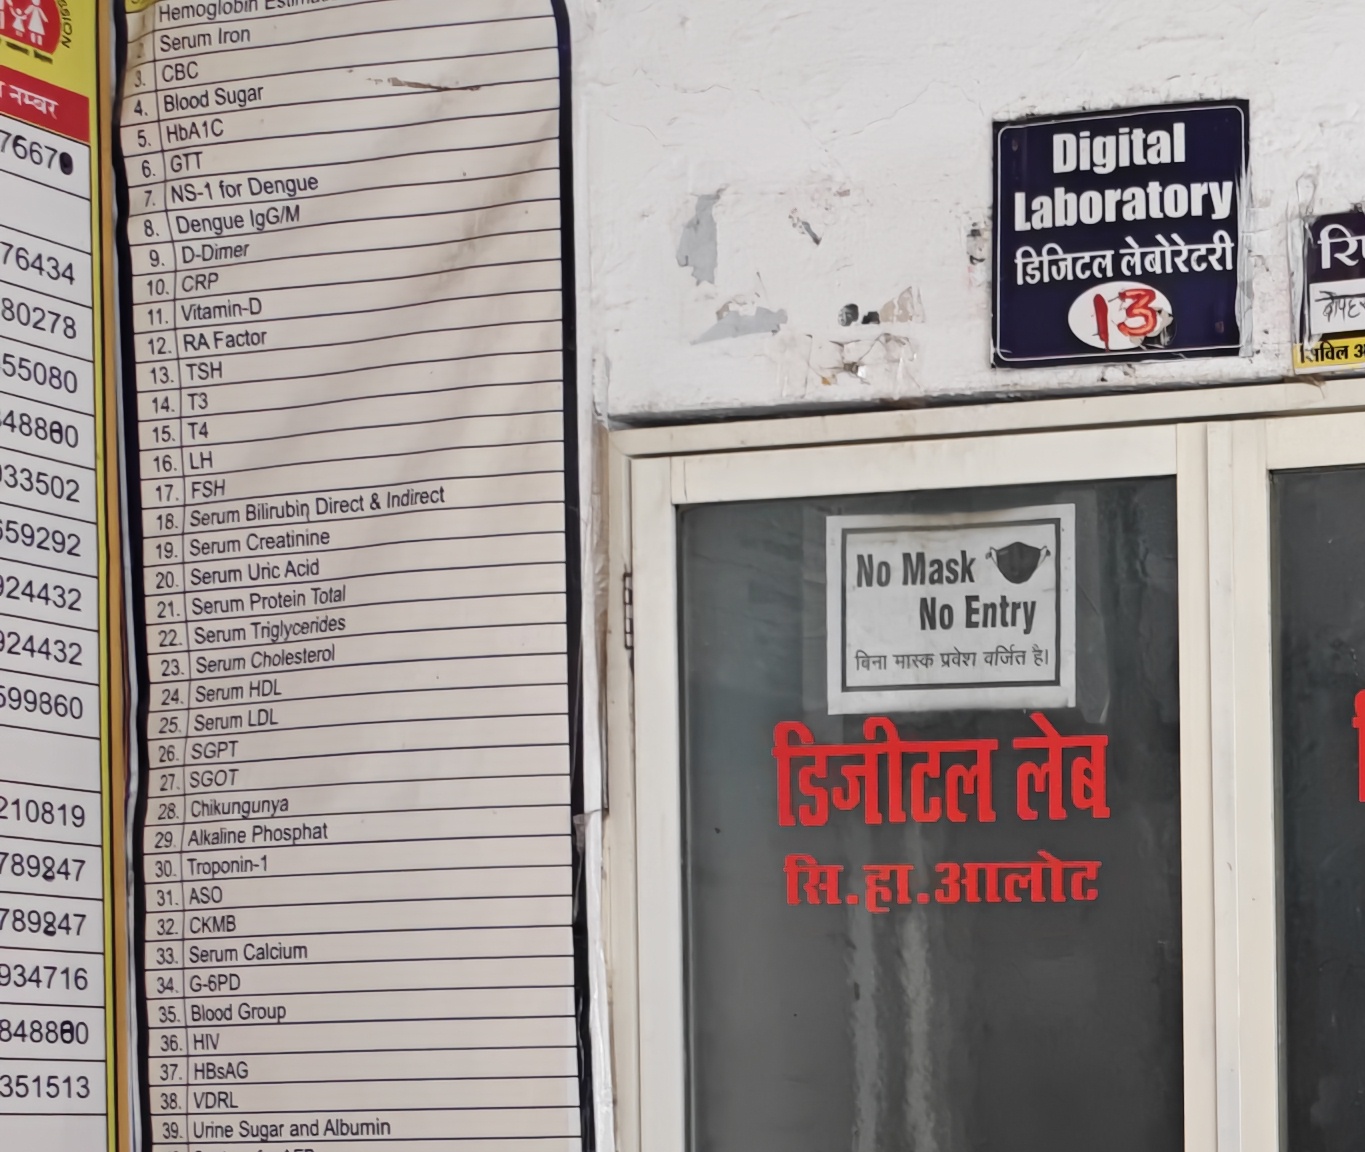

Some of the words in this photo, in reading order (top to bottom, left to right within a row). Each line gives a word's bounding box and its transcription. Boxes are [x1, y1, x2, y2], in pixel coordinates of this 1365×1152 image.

[158, 0, 259, 23] Hemoglobin
[160, 32, 213, 53] Serum
[218, 28, 251, 46] Iron
[162, 62, 199, 82] CBC
[9, 84, 59, 119] नम्बर
[163, 89, 209, 112] Blood
[214, 85, 263, 108] Sugar
[166, 119, 224, 143] HbA1C
[1053, 122, 1185, 174] Digital
[170, 152, 203, 173] GTT
[171, 182, 213, 202] NS-1
[219, 180, 242, 198] for
[248, 175, 319, 198] Dengue
[1014, 181, 1233, 231] Laboratory
[176, 213, 244, 234] Dengue
[250, 205, 300, 230] IgG/M
[181, 242, 250, 263] D-Dimer
[1014, 243, 1114, 285] डिजिटल
[1119, 229, 1234, 276] लेबोरेटरी
[181, 273, 218, 292] CRP
[181, 298, 262, 322] Vitamin-D
[1093, 288, 1157, 351] 13
[183, 330, 210, 352] RA
[213, 329, 267, 349] Factor
[185, 362, 223, 381] TSH
[187, 392, 208, 411] T3
[187, 421, 209, 440] T4
[189, 452, 213, 470] LH
[191, 479, 226, 499] FSH
[190, 507, 240, 527] Serum
[245, 500, 309, 522] Bilirubin
[316, 494, 364, 516] Direct
[369, 492, 381, 510] &
[387, 486, 445, 508] Indirect
[856, 553, 891, 588] No
[902, 550, 976, 586] Mask
[920, 597, 954, 631] No
[965, 595, 1037, 635] Entry
[194, 624, 246, 644] Serum
[251, 615, 346, 642] Triglycerides
[855, 650, 887, 672] बिना
[894, 650, 934, 670] मास्क
[940, 646, 977, 669] प्रवेश
[984, 644, 1026, 667] वर्जित
[191, 741, 238, 760] SGPT
[189, 768, 239, 788] SGOT
[771, 716, 999, 827] डिजीटल
[1013, 712, 1110, 822] लेब
[190, 797, 289, 820] Chikungunya
[188, 824, 246, 847] Alkaline
[251, 822, 328, 845] Phosphat
[187, 855, 268, 878] Troponin-1
[189, 886, 223, 905] ASO
[190, 915, 236, 935] CKMB
[190, 973, 241, 993] G-6PD
[191, 1003, 233, 1022] Blood
[238, 1003, 287, 1023] Group
[194, 1033, 220, 1051] HIV
[194, 1061, 249, 1081] HBsAG
[193, 1091, 239, 1110] VDRL
[193, 1121, 234, 1139] Urine
[239, 1119, 285, 1142] Sugar
[290, 1118, 319, 1137] and
[323, 1118, 391, 1137] Albumin
